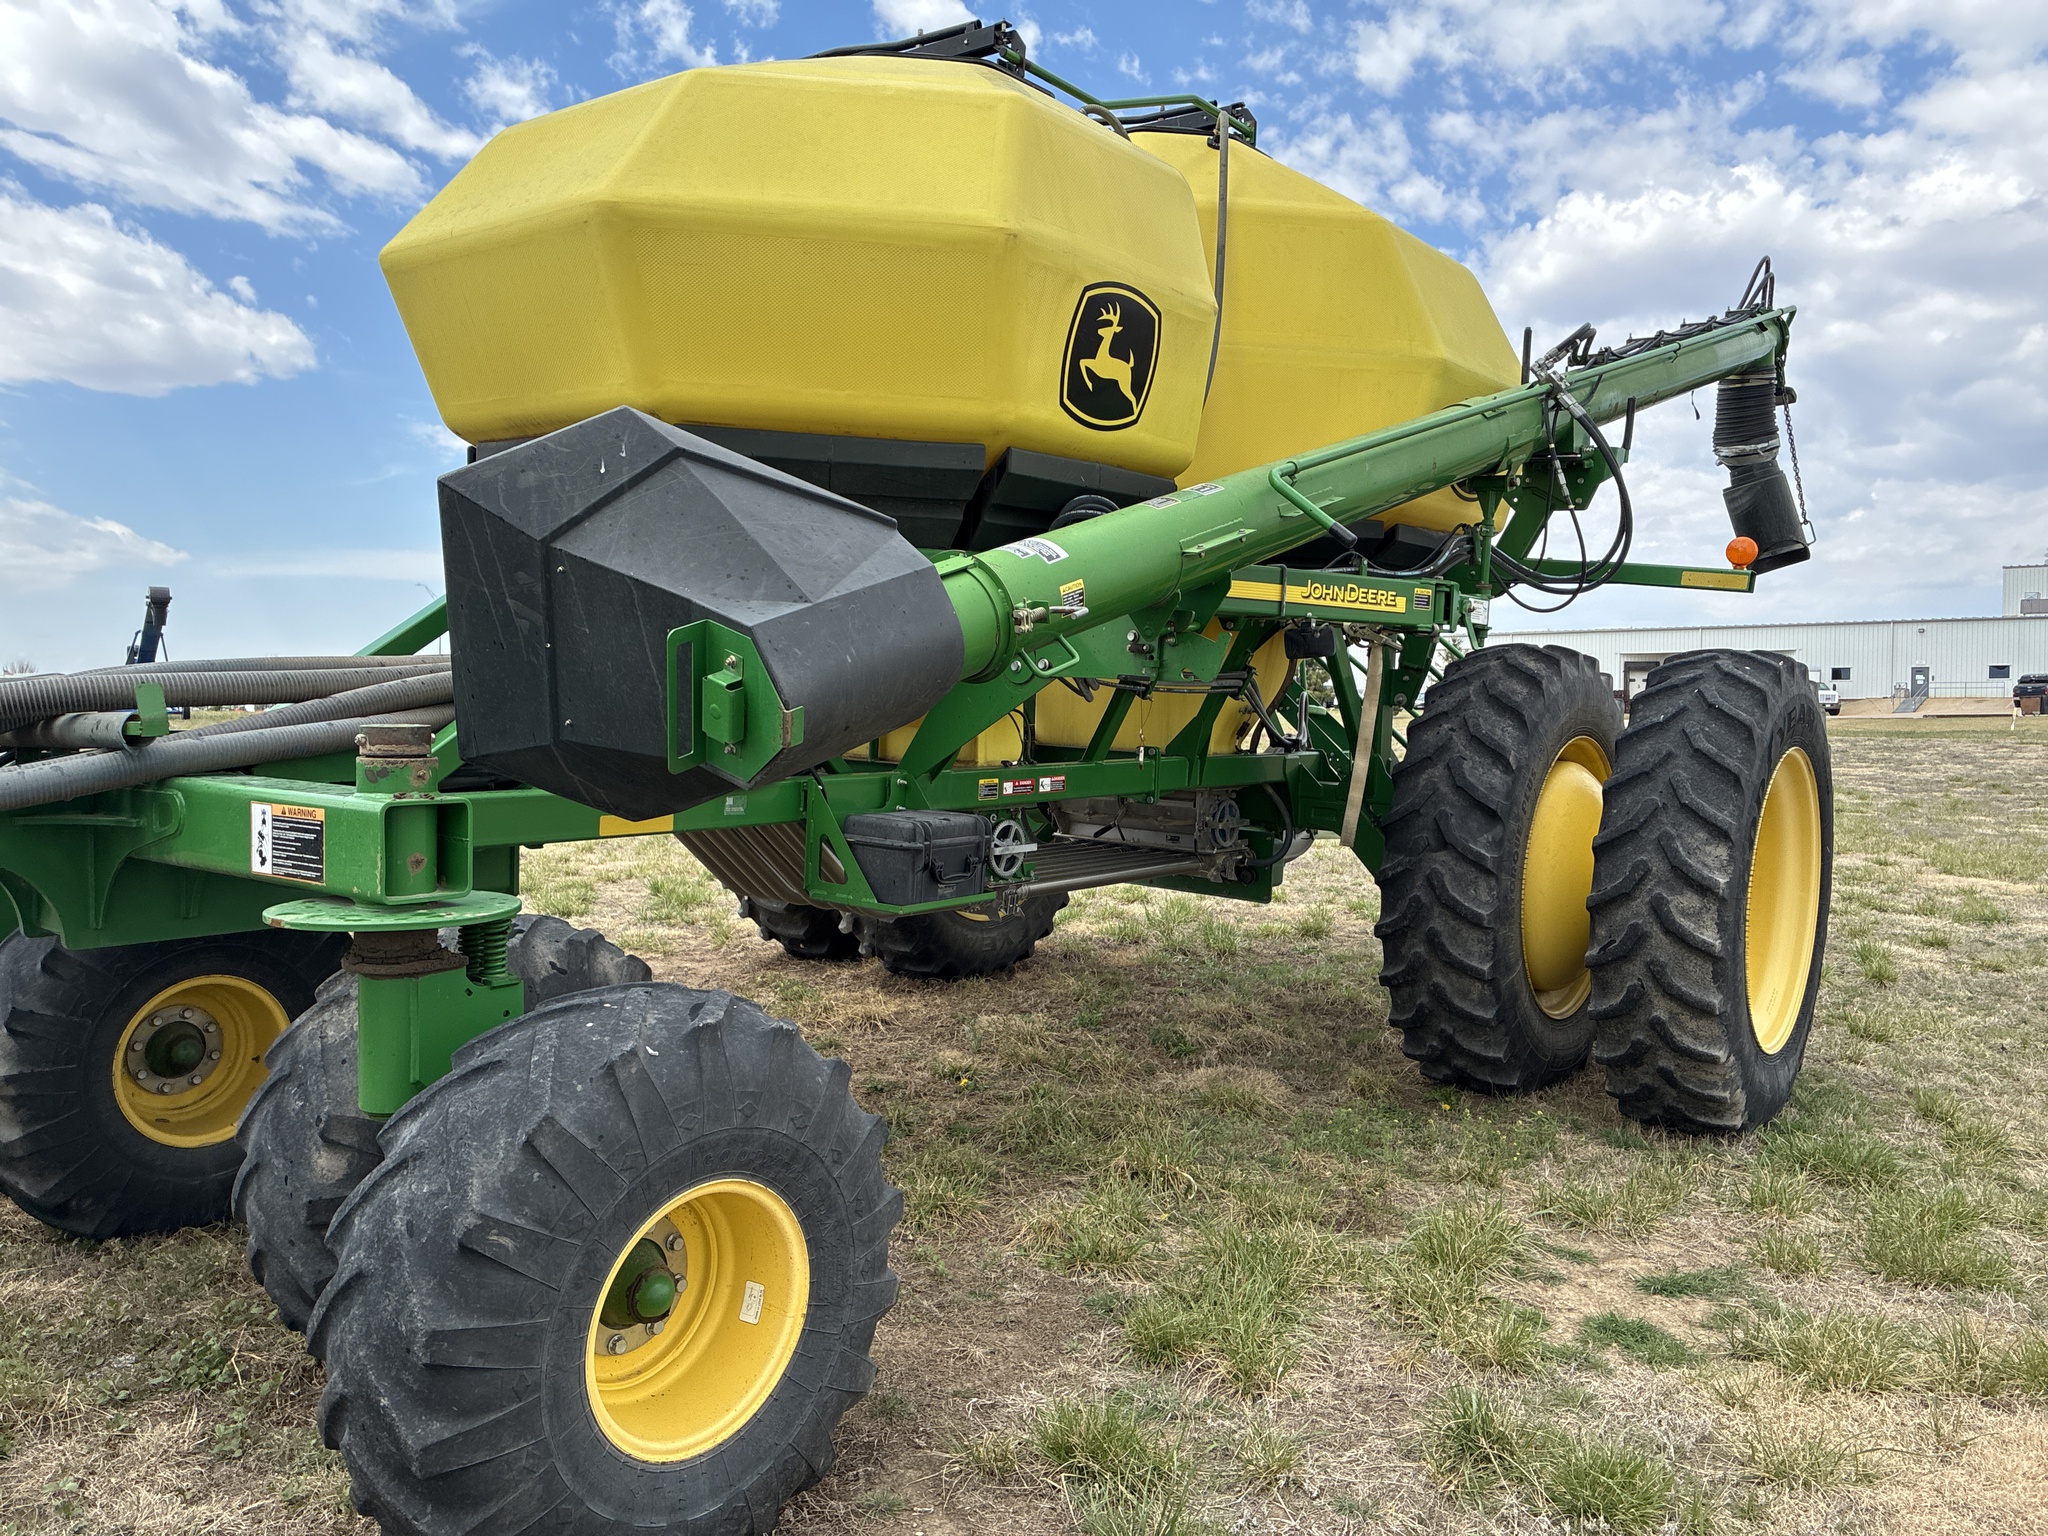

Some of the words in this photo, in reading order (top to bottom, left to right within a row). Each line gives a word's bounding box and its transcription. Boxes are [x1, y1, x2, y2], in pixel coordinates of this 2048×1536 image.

[1301, 579, 1345, 602] JOHN
[1346, 583, 1398, 606] DEERE
[1521, 767, 1538, 816] PLUS
[287, 806, 317, 819] WARNING
[702, 1148, 827, 1218] GOODYEAR
